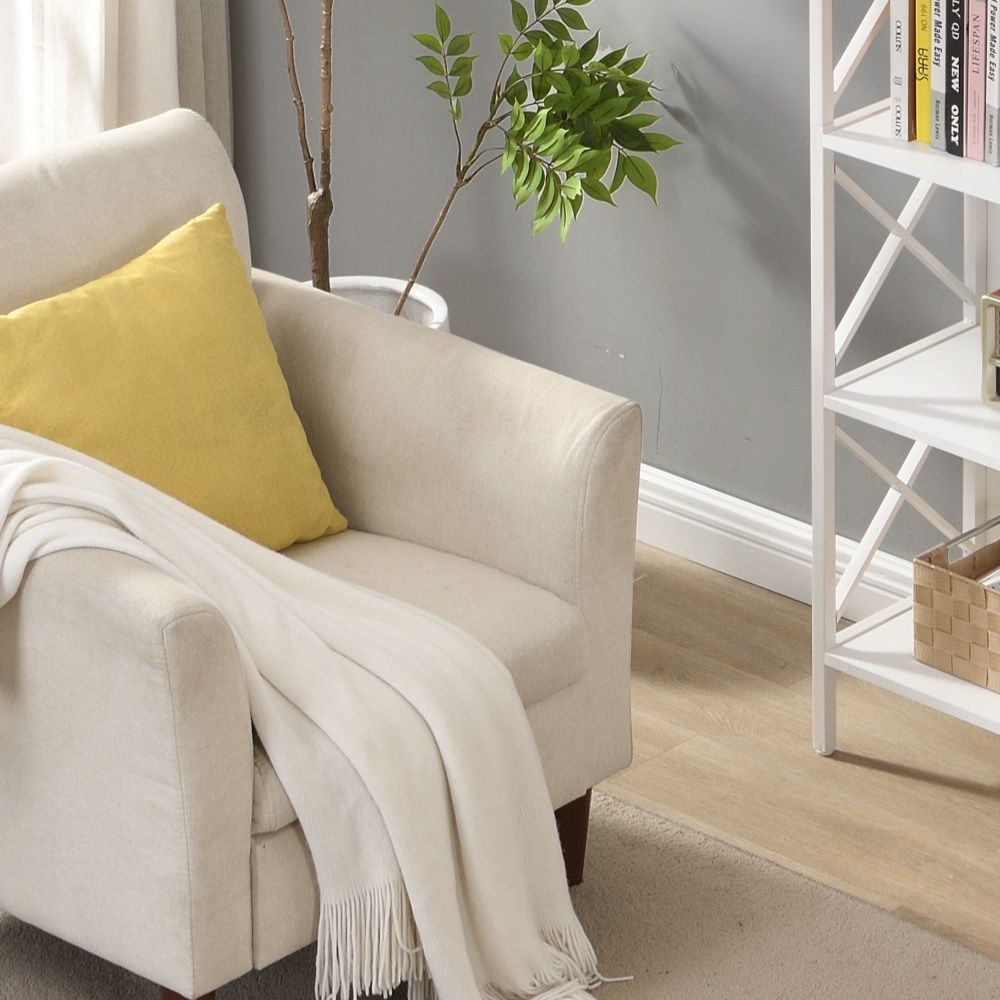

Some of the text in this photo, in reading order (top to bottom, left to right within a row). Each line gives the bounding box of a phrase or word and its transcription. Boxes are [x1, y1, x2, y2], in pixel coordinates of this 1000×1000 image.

[989, 2, 998, 32] Power
[933, 20, 943, 45] Made
[950, 22, 960, 40] QD
[932, 46, 943, 67] Easy
[971, 14, 980, 74] LIFESPAN
[989, 33, 998, 58] Made
[951, 56, 960, 93] NEW
[987, 61, 997, 82] Easy
[950, 104, 959, 146] ONLY
